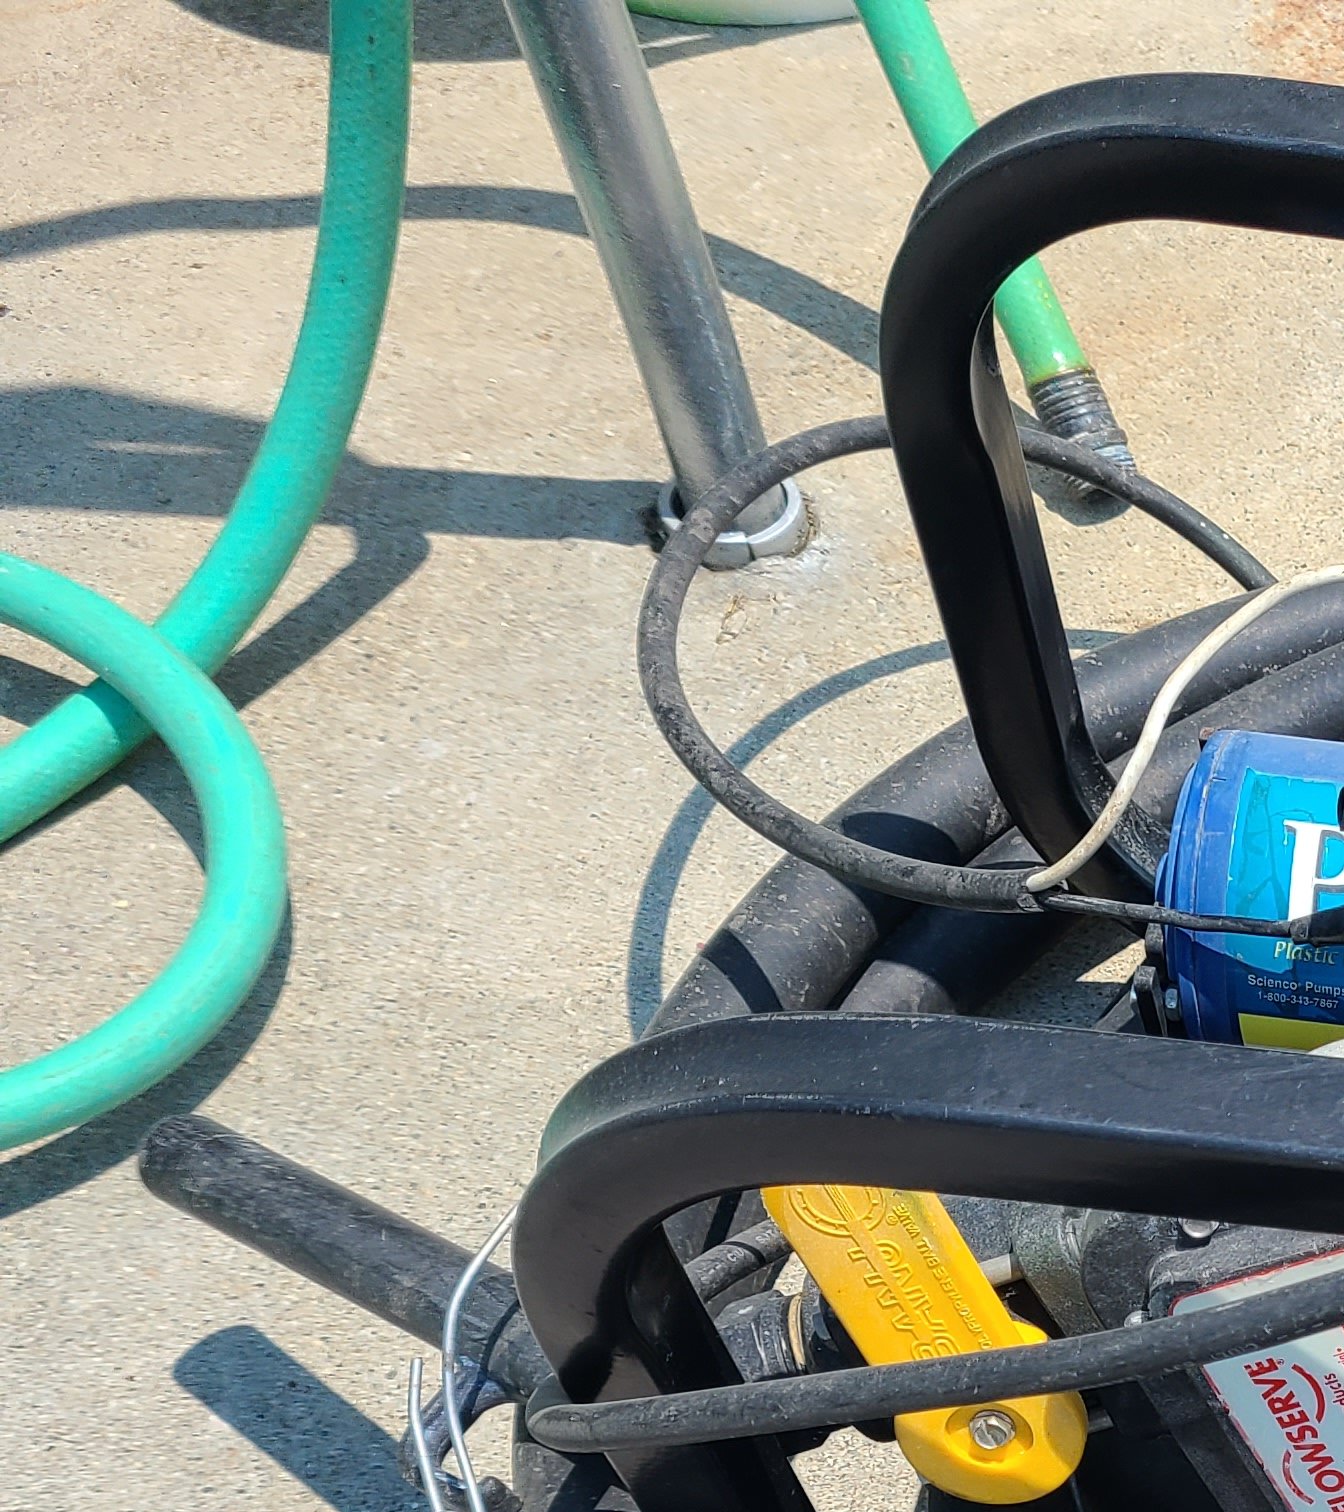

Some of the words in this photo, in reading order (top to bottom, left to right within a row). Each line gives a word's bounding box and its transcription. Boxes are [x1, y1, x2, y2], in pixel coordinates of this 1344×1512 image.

[1273, 940, 1340, 967] Plastic
[1247, 974, 1301, 991] Scienco
[892, 1202, 921, 1240] VALVE
[916, 1236, 940, 1270] BALL
[932, 1264, 993, 1350] OLYPROPYLENE
